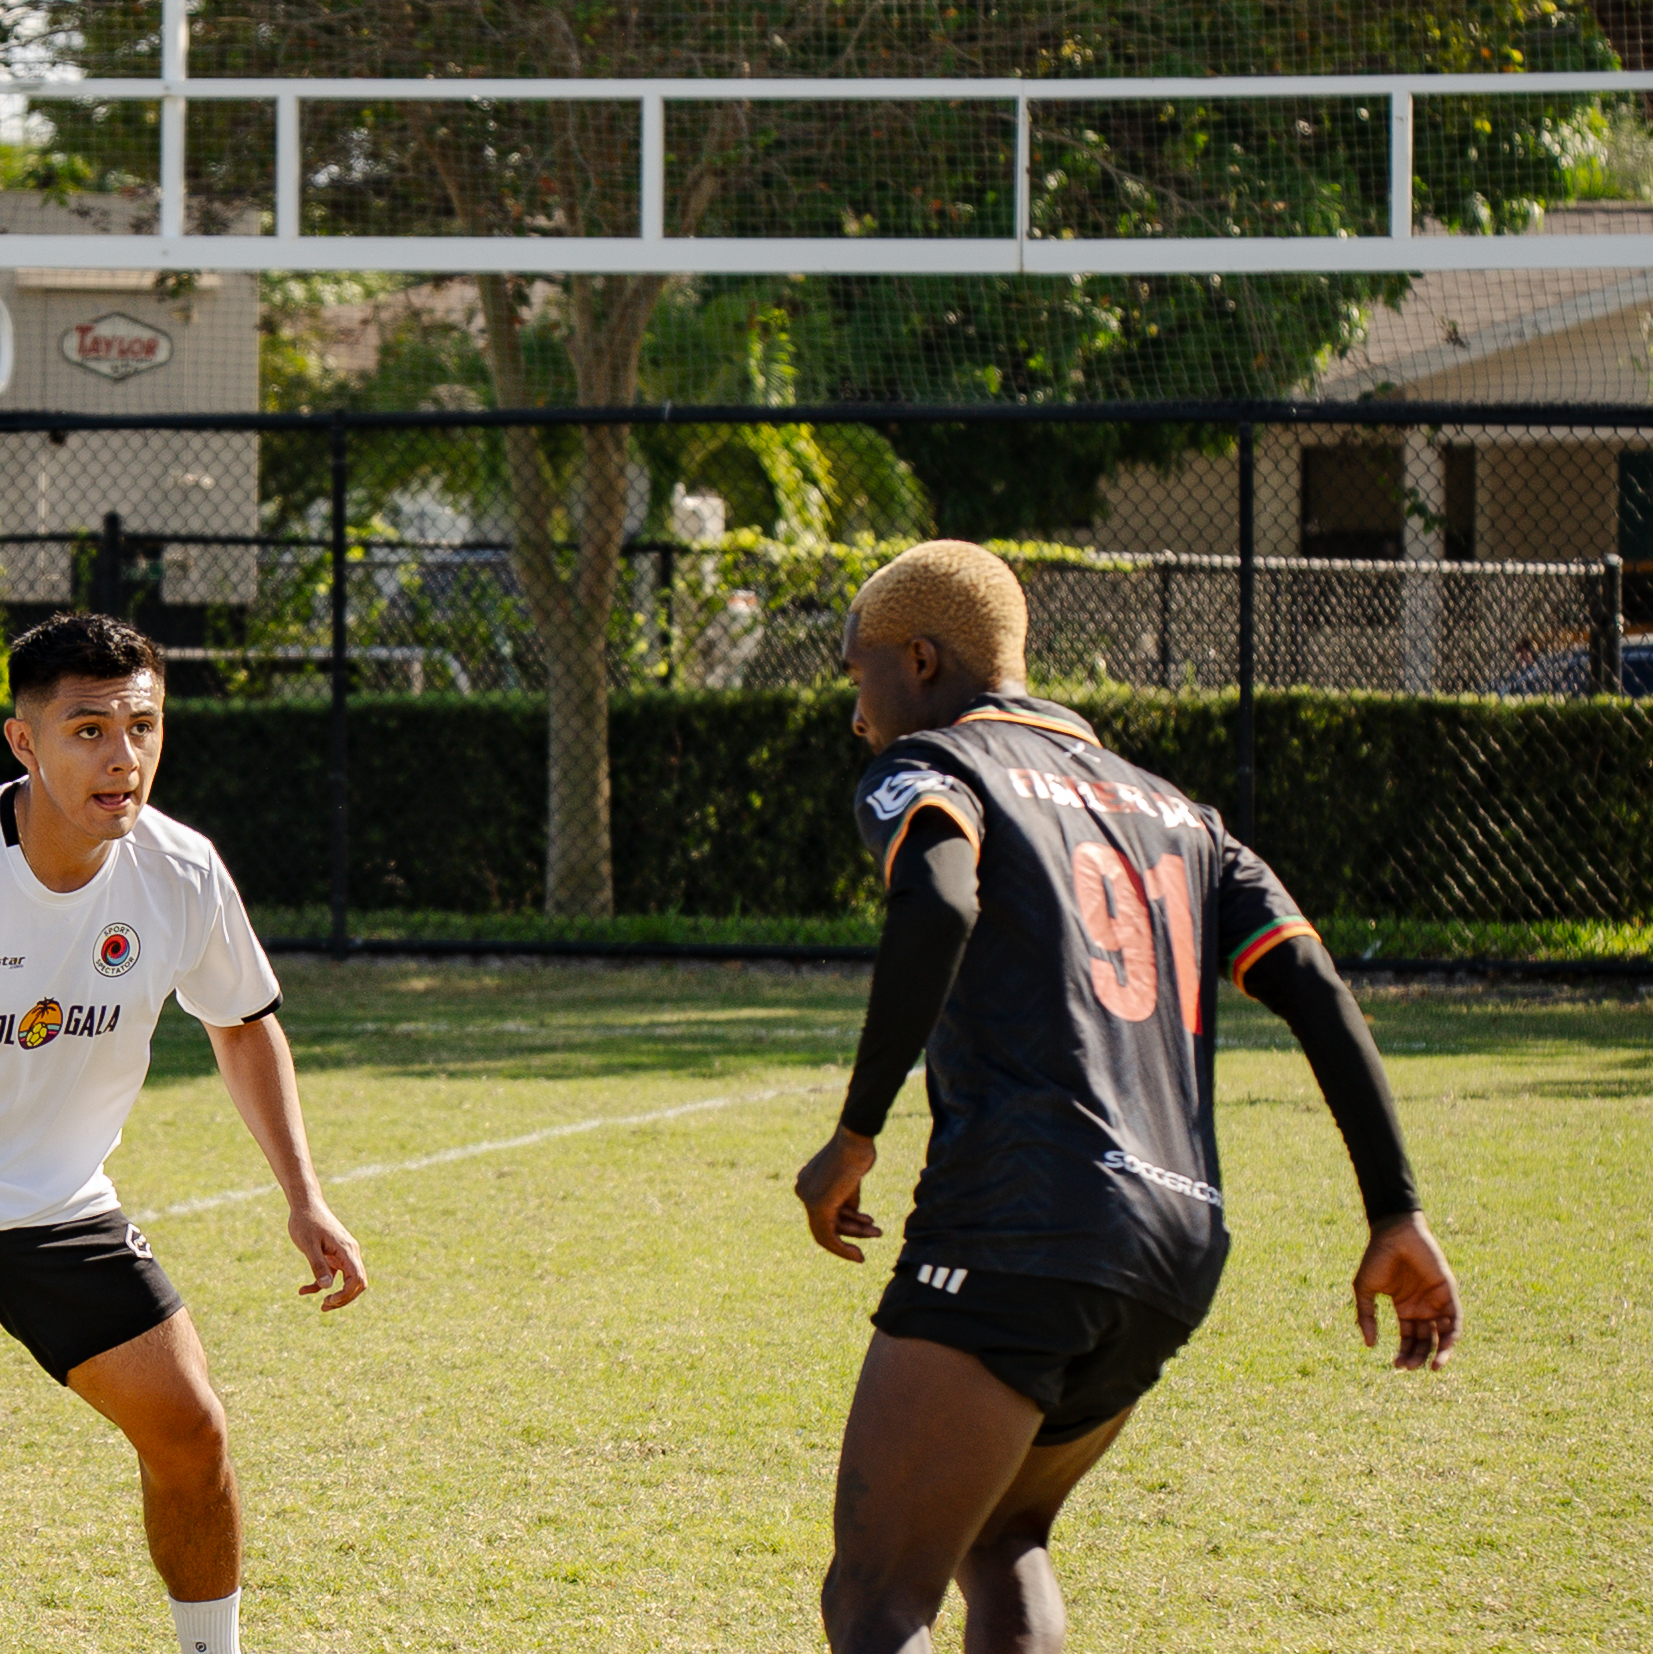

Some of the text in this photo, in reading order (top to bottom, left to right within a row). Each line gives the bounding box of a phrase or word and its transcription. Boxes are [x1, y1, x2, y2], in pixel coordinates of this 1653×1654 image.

[103, 925, 130, 937] SPORT
[1072, 841, 1203, 1035] 91
[96, 956, 135, 975] SPECTATOR
[63, 1004, 121, 1038] GALA
